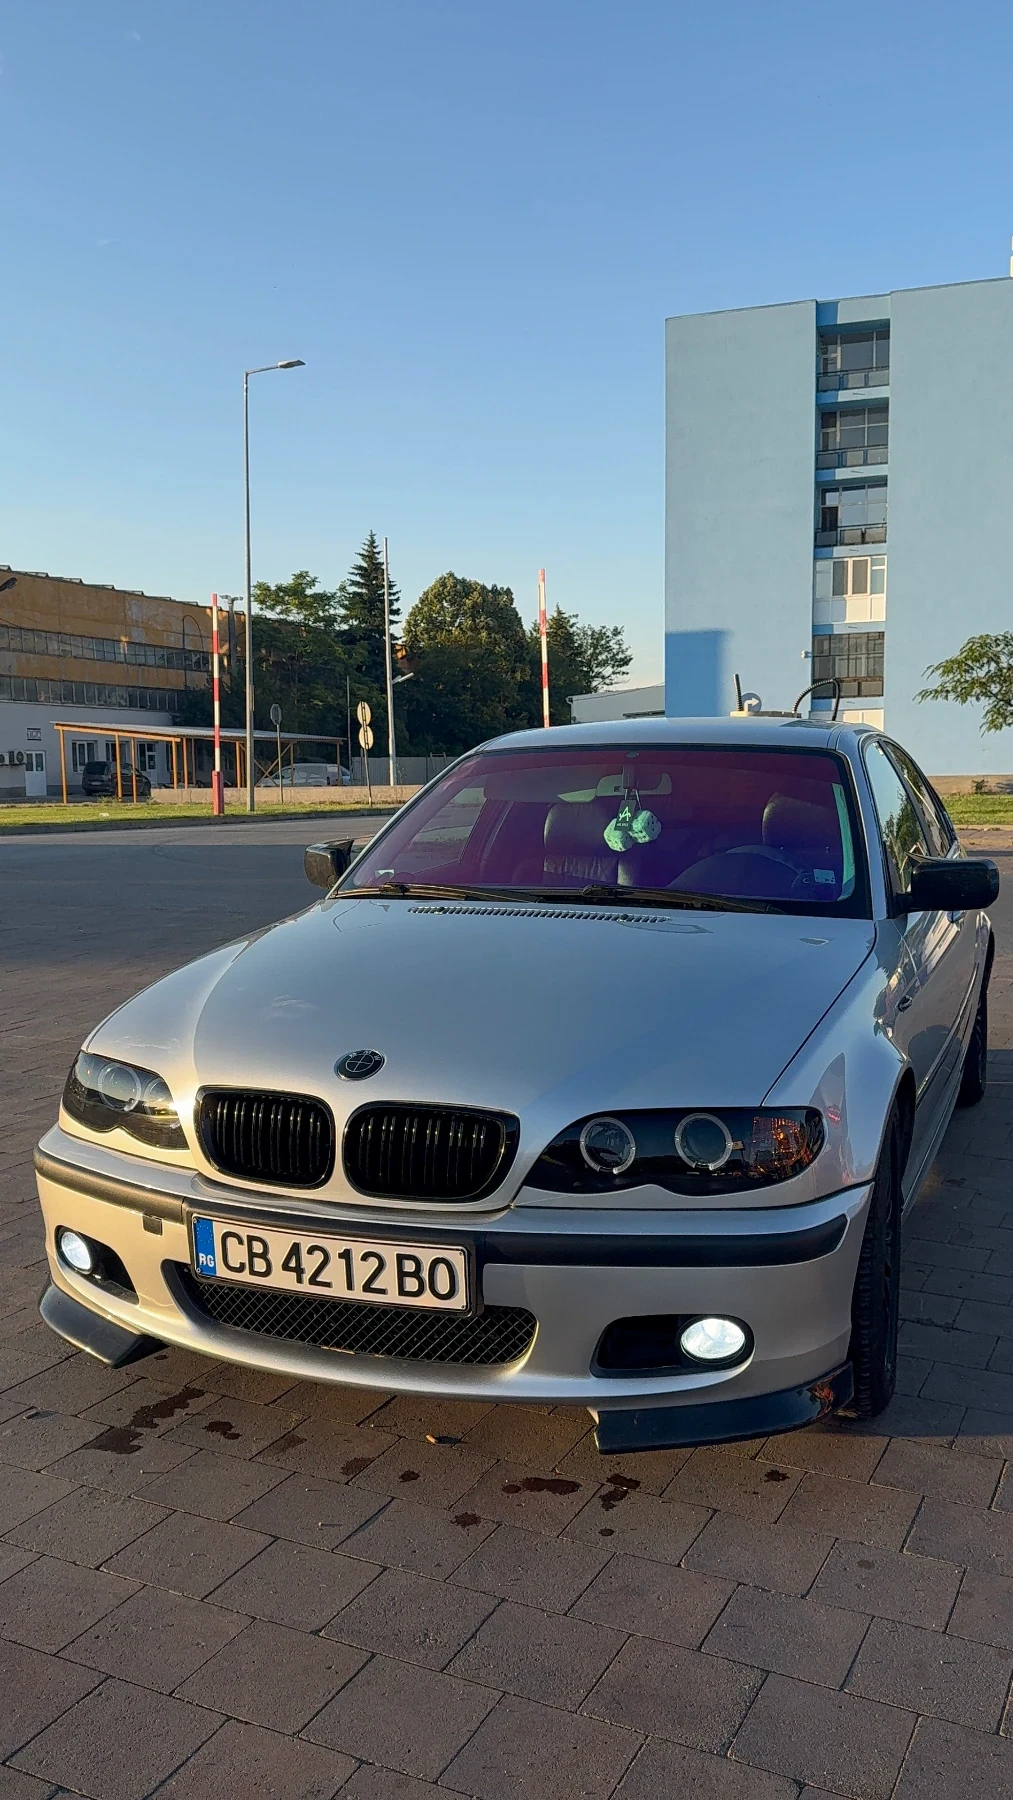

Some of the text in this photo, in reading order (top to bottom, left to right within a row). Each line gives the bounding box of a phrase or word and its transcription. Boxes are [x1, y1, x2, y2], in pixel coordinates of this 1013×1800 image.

[198, 1253, 215, 1268] BG
[220, 1230, 272, 1279] CB
[281, 1241, 387, 1295] 4212
